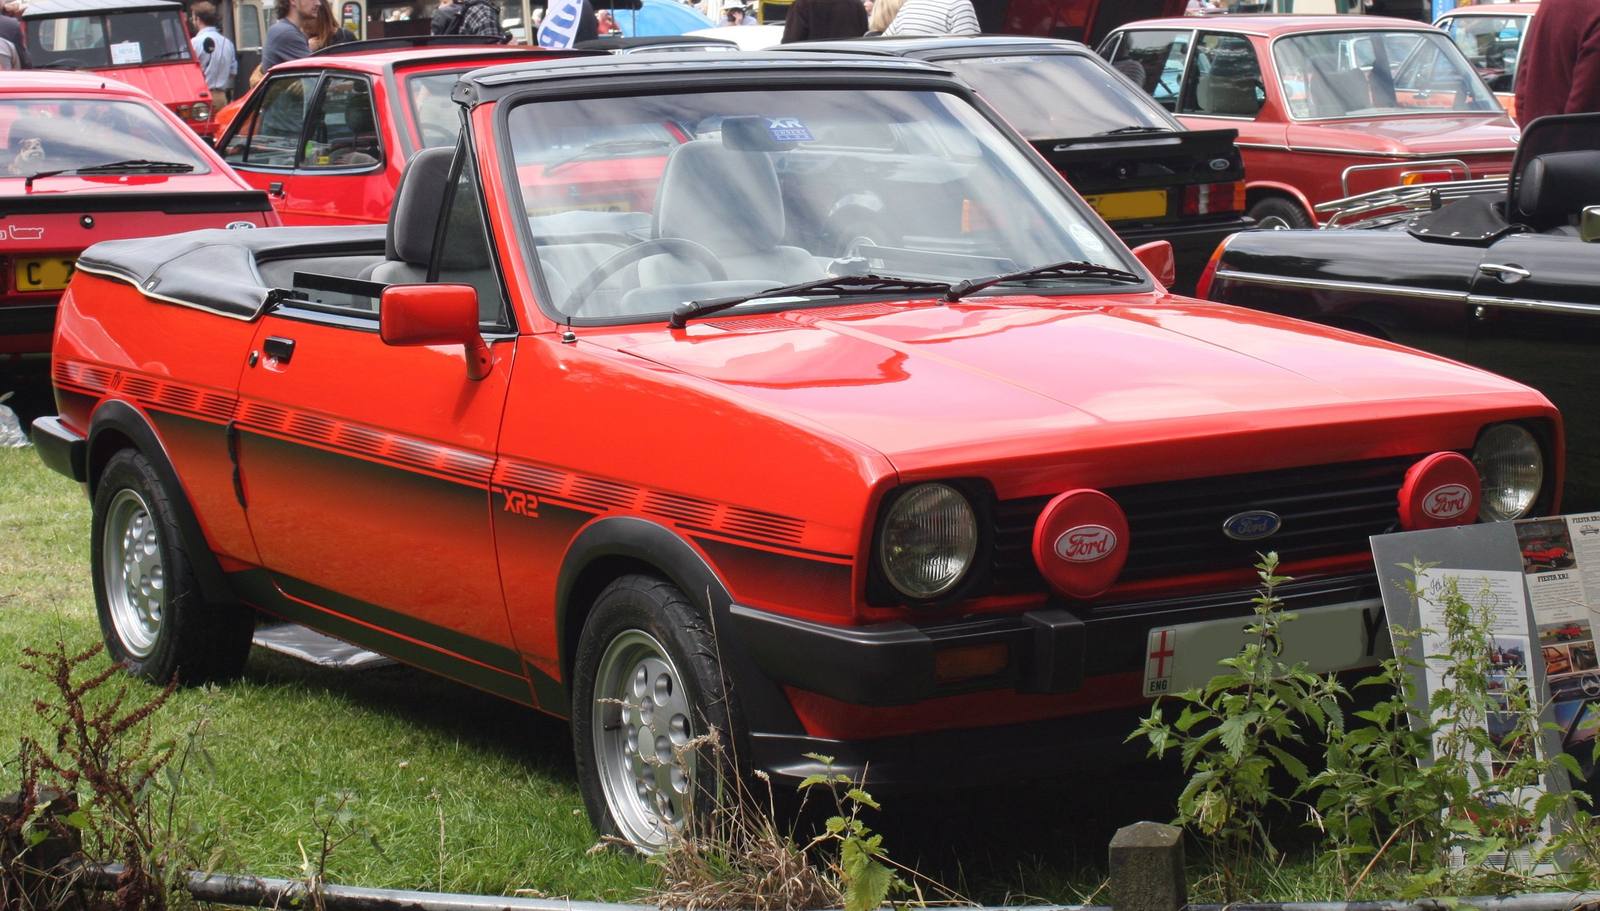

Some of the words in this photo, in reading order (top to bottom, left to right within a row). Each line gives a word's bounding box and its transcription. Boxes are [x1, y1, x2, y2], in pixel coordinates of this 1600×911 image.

[767, 118, 803, 128] XR
[503, 488, 539, 518] XR2
[1432, 491, 1467, 513] Ford
[1238, 516, 1269, 534] Ford
[1066, 532, 1108, 557] Ford
